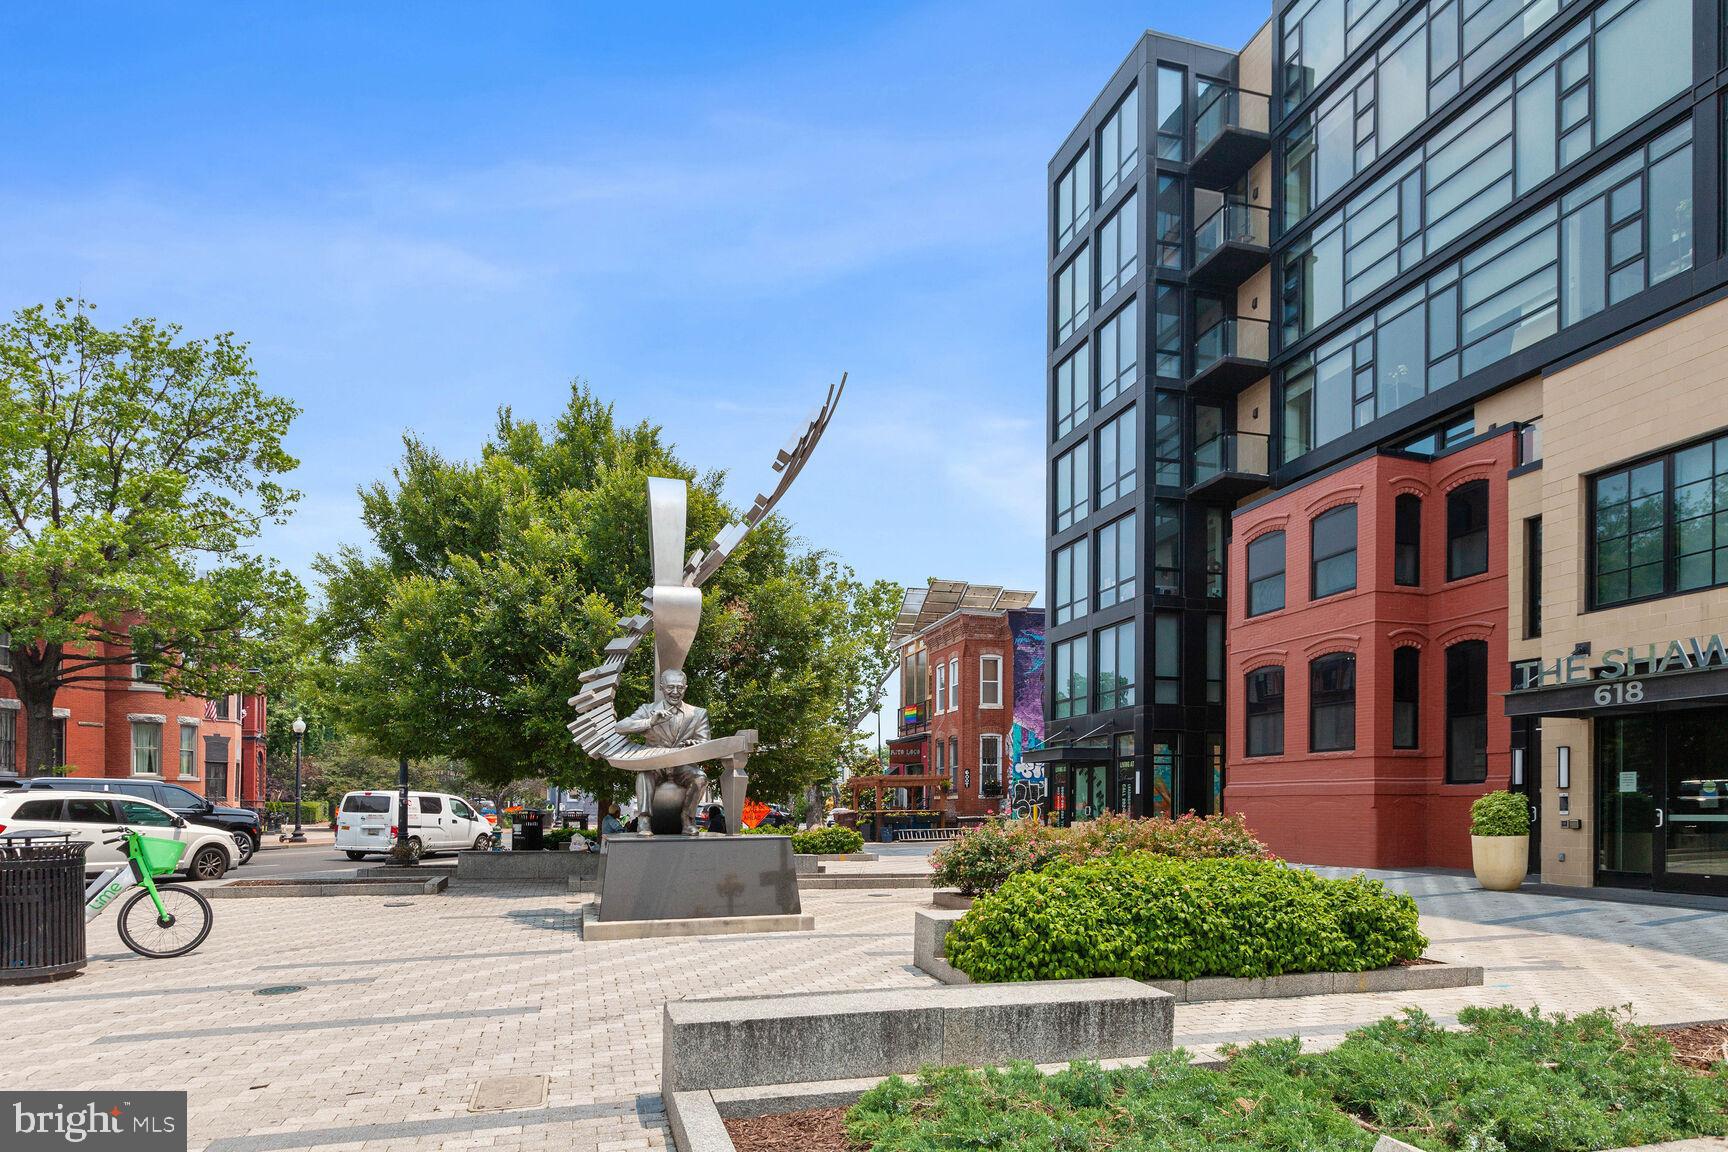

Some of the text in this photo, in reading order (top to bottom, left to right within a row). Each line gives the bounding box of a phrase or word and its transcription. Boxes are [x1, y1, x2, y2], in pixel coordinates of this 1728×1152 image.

[1516, 634, 1728, 690] THE SHAW
[1594, 681, 1644, 706] 618
